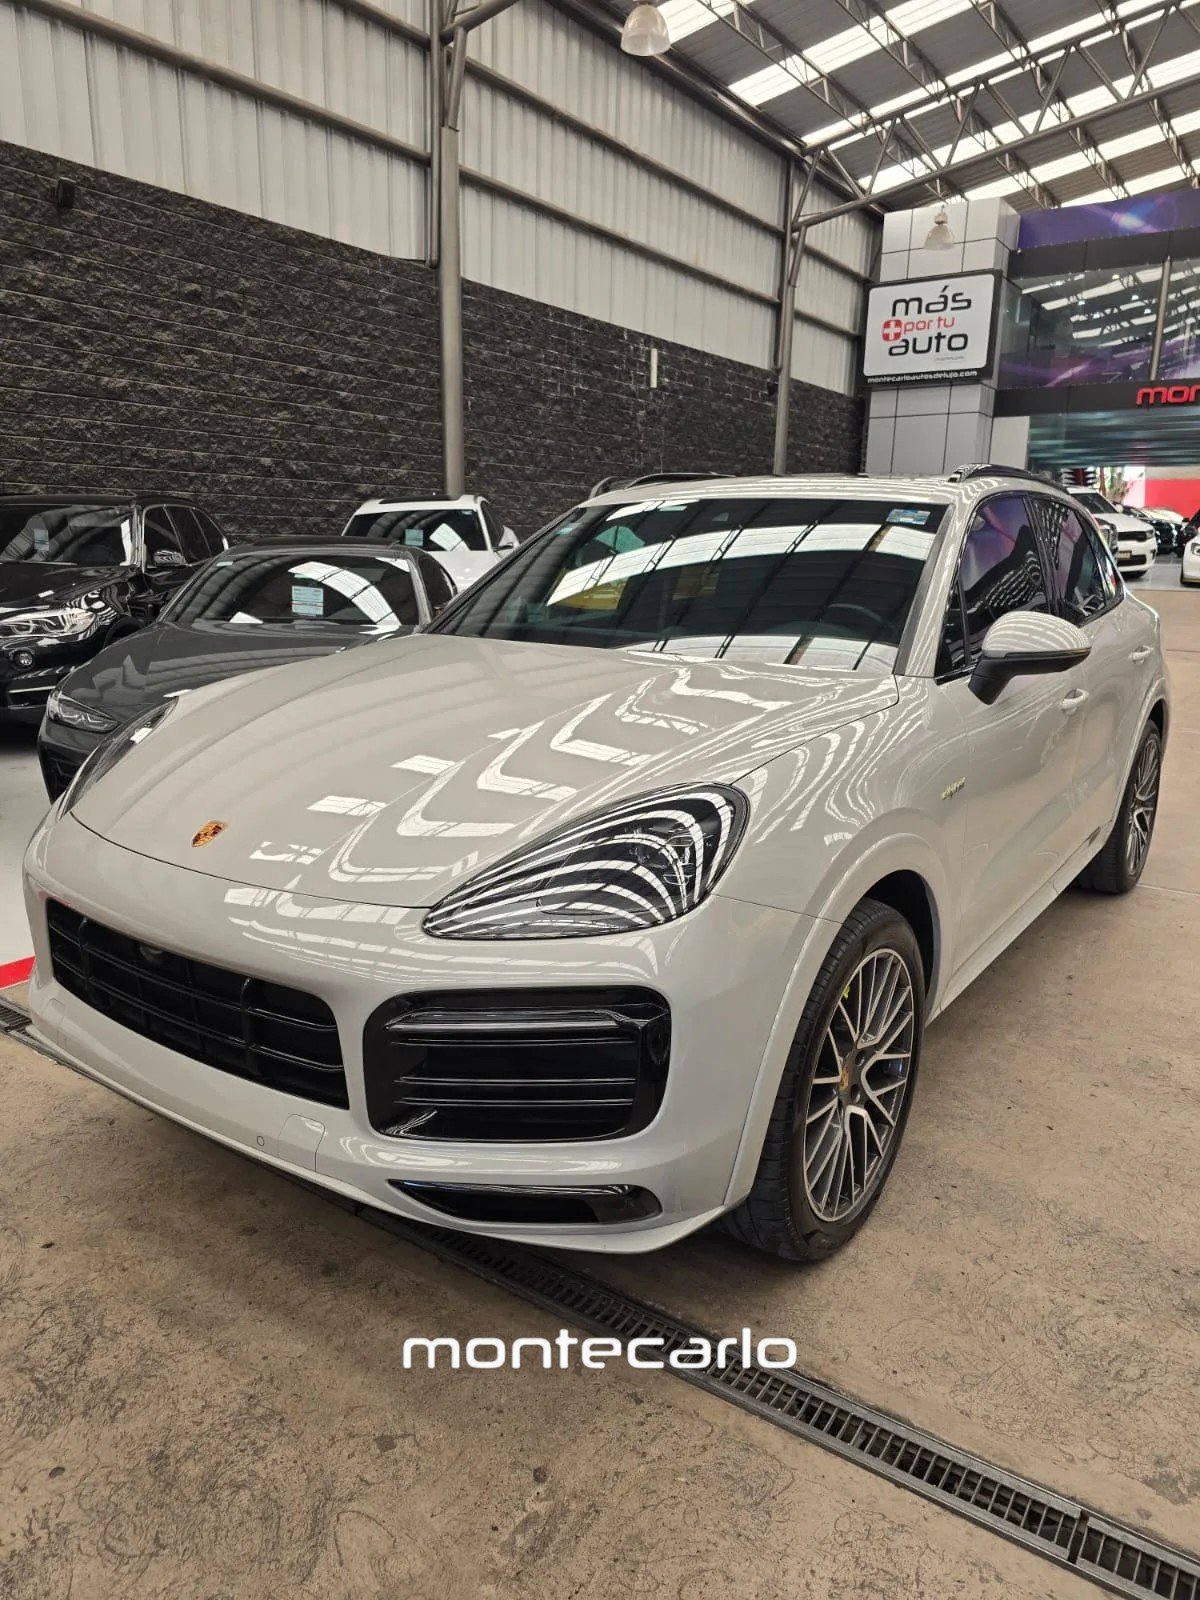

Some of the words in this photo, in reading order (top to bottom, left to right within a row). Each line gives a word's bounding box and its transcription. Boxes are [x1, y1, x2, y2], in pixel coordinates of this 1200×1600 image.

[891, 284, 972, 317] más
[903, 319, 933, 334] por
[937, 316, 955, 329] tu
[888, 332, 969, 356] auto
